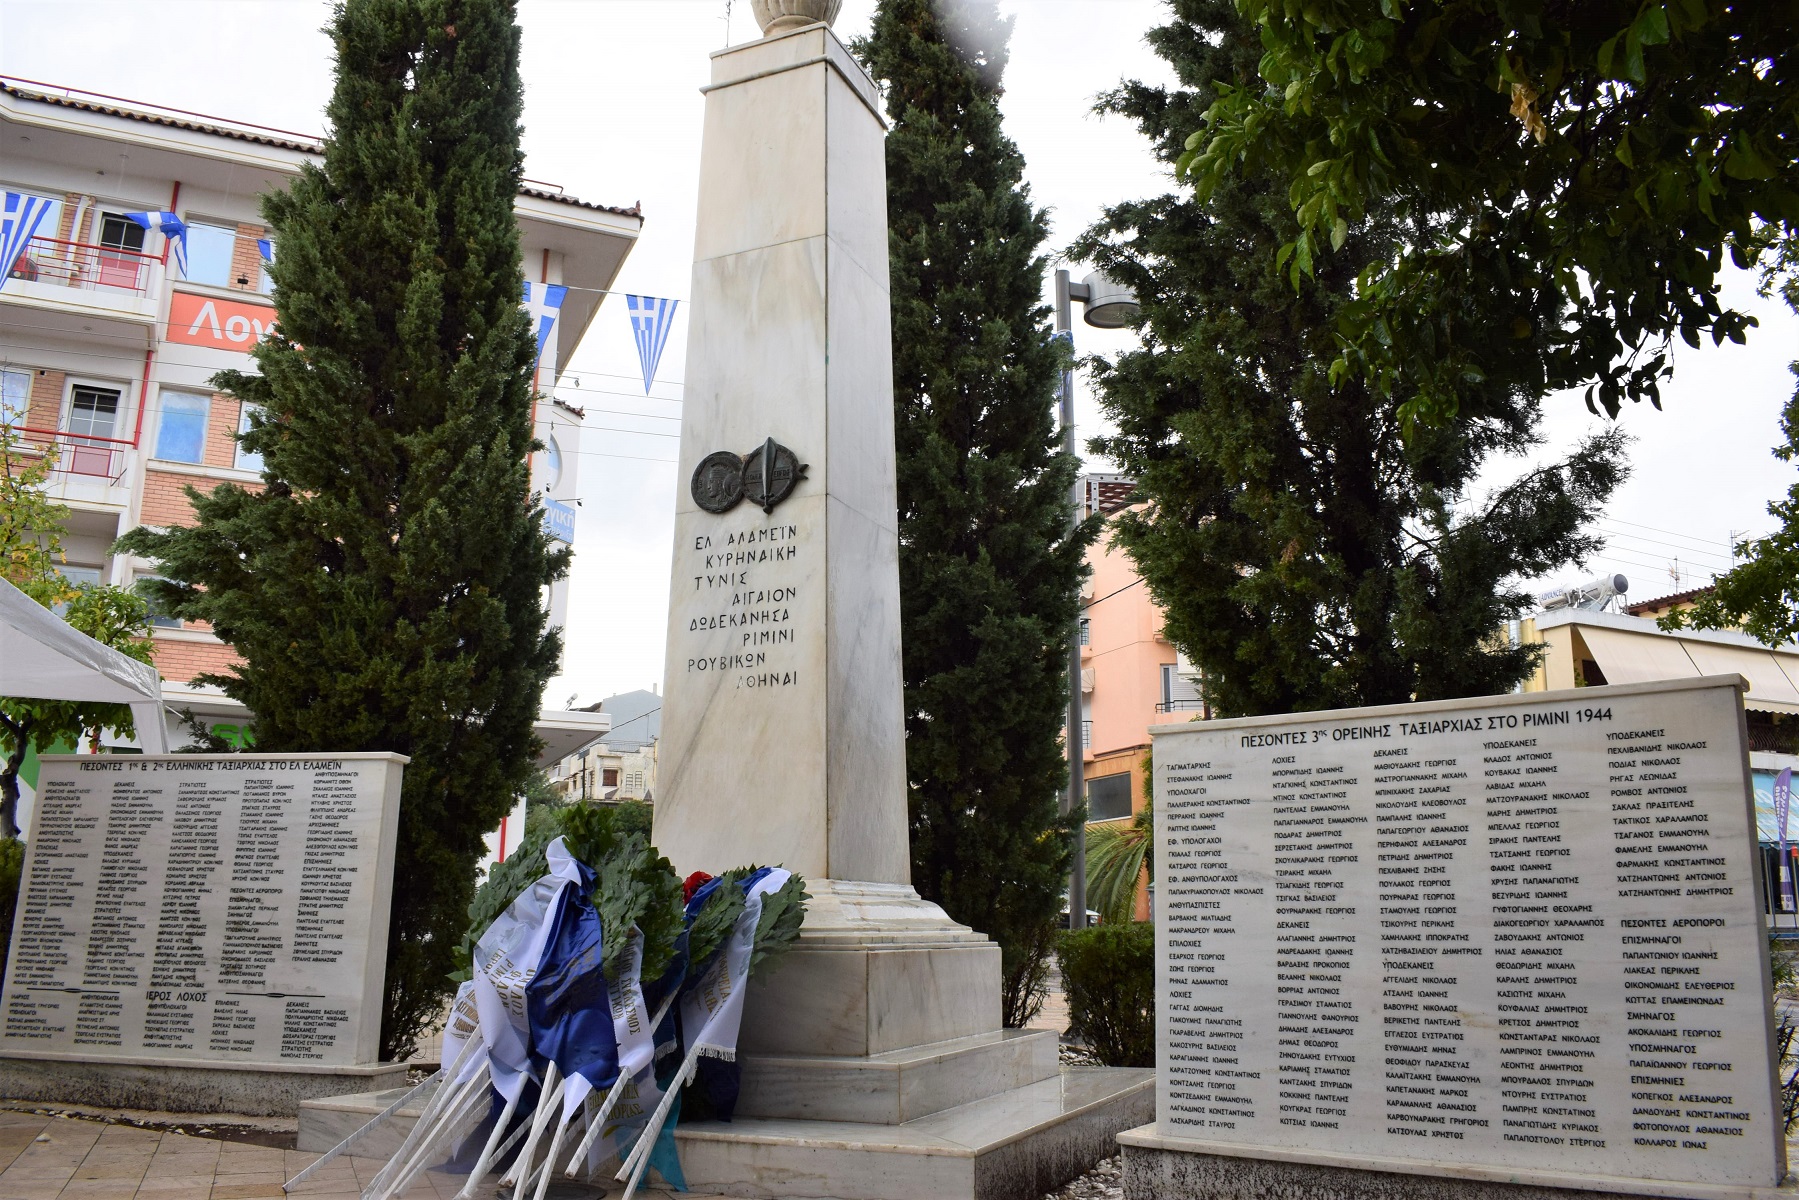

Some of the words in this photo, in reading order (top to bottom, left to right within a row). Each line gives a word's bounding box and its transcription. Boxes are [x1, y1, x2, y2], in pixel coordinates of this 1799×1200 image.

[695, 535, 712, 550] ΕΛ
[705, 545, 796, 569] ΚΥΡΗΝΑΙΚΗ
[694, 571, 748, 590] ΤΥΝΙΣ
[732, 586, 796, 606] ΑΙΓΑΙΟΝ
[689, 608, 790, 631] ΔΩΔΕΚΑΝΗΣΑ
[743, 628, 794, 647] ΡΙΜΙΝΙ
[687, 652, 766, 673] ΡΟΥΒΙΚΩΝ
[736, 670, 797, 690] ΑΘΗΝΑΙ
[1240, 730, 1308, 748] ΠΕΣΟΝΤΕΣ
[1331, 723, 1392, 742] ΟΡΕΙΝΗΣ
[1398, 716, 1483, 736] ΤΑΞΙΑΡΧΙΑΣ
[1486, 714, 1518, 730] ΣΤΟ
[1522, 710, 1570, 727] ΡΙΜΙΝΙ
[1575, 707, 1613, 723] 1944
[1605, 728, 1666, 741] ΥΠΟΔΕΚΑΝΕΙΣ
[1482, 738, 1538, 750] ΥΠΟΔΕΚΑΝΕΙΣ
[1606, 743, 1662, 755] ΠΕΧΛΙΒΑΝΙΔΗΣ
[1666, 740, 1707, 751] ΝΙΚΟΛΑΟΣ
[1372, 747, 1408, 758] ΔΕΚΑΝΕΙΣ
[1483, 754, 1512, 764] ΚΛΑΔΟΣ
[1515, 751, 1553, 762] ΑΝΤΩΝΙΟΣ
[1271, 755, 1296, 764] ΛΟΧΙΕΣ
[1373, 760, 1421, 770] ΜΑΘΙΟΥΔΑΚΗΣ
[1424, 758, 1457, 768] ΓΕΩΡΓΙΟΣ
[1608, 759, 1637, 769] ΠΟΔΙΑΣ
[1640, 756, 1681, 767] ΝΙΚΟΛΑΟΣ
[79, 762, 124, 771] ΠΕΣΟΝΤΕΣ
[166, 761, 215, 771] ΕΛΛΗΝΙΚΗΣ
[217, 761, 267, 771] ΤΑΞΙΑΡΧΙΑΣ
[268, 761, 287, 771] ΣΤΟ
[289, 761, 301, 771] ΕΛ
[1165, 761, 1211, 771] ΤΑΓΜΑΤΑΡΧΗΣ
[1483, 767, 1522, 777] ΚΟΥΒΑΚΑΣ
[1524, 765, 1558, 775] ΙΩΑΝΝΗΣ
[1373, 772, 1438, 783] ΜΑΣΤΡΟΓΙΑΝΝΑΚΗΣ
[1440, 771, 1468, 780] ΜΙΧΑΗΛ
[1609, 774, 1634, 783] ΡΗΓΑΣ
[1638, 771, 1677, 781] ΛΕΩΝΙΔΑΣ
[1418, 785, 1451, 794] ΖΑΧΑΡΙΑΣ
[1484, 781, 1515, 791] ΛΑΒΙΔΑΣ
[1518, 780, 1547, 788] ΜΙΧΑΗΛ
[1646, 785, 1688, 795] ΑΝΤΩΝΙΟΣ
[1485, 793, 1548, 804] ΜΑΤΖΟΥΡΑΝΑΚΗΣ
[1551, 790, 1590, 800] ΝΙΚΟΛΑΟΣ
[1375, 800, 1418, 809] ΝΙΚΟΛΟΥΔΗΣ
[1421, 797, 1467, 807] ΚΛΕΟΒΟΥΛΟΣ
[1611, 802, 1642, 812] ΣΑΚΛΑΣ
[1645, 799, 1695, 810] ΠΡΑΞΙΤΕΛΗΣ
[1273, 805, 1307, 814] ΠΑΝΤΕΛΙΑΣ
[1310, 804, 1350, 813] ΕΜΜΑΝΟΥΗΛ
[1486, 808, 1511, 817] ΜΑΡΗΣ
[1514, 806, 1558, 817] ΔΗΜΗΤΡΙΟΣ
[1612, 816, 1651, 825] ΤΑΚΤΙΚΟΣ
[1654, 813, 1709, 824] ΧΑΡΑΛΑΜΠΟΣ
[1487, 822, 1521, 831] ΜΠΕΛΛΑΣ
[1524, 820, 1560, 830] ΓΕΩΡΓΙΟΣ
[1488, 836, 1519, 845] ΣΙΡΑΚΗΣ
[1522, 834, 1562, 843] ΠΑΝΤΕΛΗΣ
[1613, 830, 1654, 840] ΤΣΑΓΑΝΟΣ
[1658, 828, 1710, 838] ΕΜΜΑΝΟΥΗΛ
[1488, 849, 1531, 859] ΤΣΑΤΣΑΝΗΣ
[1535, 848, 1571, 857] ΓΕΩΡΓΙΟΣ
[1614, 844, 1653, 854] ΦΑΜΕΛΗΣ
[1657, 843, 1709, 853] ΕΜΜΑΝΟΥΗΛ
[1615, 859, 1659, 868] ΦΑΡΜΑΚΗΣ
[1663, 857, 1726, 867] ΚΩΝΣΤΑΝΤΙΝΟΣ
[1167, 875, 1180, 883] ΕΦ.
[1181, 874, 1238, 883] ΑΝΘΥΠΟΛΟΓΑΧΟΣ
[1616, 873, 1680, 883] ΧΑΤΖΗΑΝΤΩΝΗΣ
[1684, 872, 1727, 881] ΑΝΤΩΝΙΟΣ
[1617, 888, 1681, 897] ΧΑΤΖΗΑΝΤΩΝΗΣ
[1685, 887, 1734, 896] ΔΗΜΗΤΡΙΟΣ
[1167, 900, 1221, 909] ΑΝΘΥΠΑΣΠΙΣΤΕΣ
[1492, 905, 1549, 914] ΓΥΦΤΟΓΙΑΝΝΗΣ
[1552, 904, 1593, 913] ΘΕΟΧΑΡΗΣ
[1276, 920, 1310, 929] ΔΕΚΑΝΕΙΣ
[1492, 919, 1550, 928] ΔΙΑΚΟΓΕΩΡΓΙΟΥ
[1553, 918, 1605, 927] ΧΑΡΑΛΑΜΠΟΣ
[1620, 918, 1667, 928] ΠΕΣΟΝΤΕΣ
[1672, 918, 1725, 928] ΑΕΡΟΠΟΡΟΙ
[1168, 939, 1202, 948] ΕΠΙΛΟΧΙΕΣ
[1621, 935, 1682, 945] ΕΠΙΣΜΗΝΑΓΟΙ
[1622, 951, 1680, 960] ΠΑΠΑΝΤΩΝΙΟΥ
[1682, 951, 1719, 960] ΙΩΑΝΝΗΣ
[1623, 966, 1656, 975] ΛΙΑΚΕΑΣ
[1660, 966, 1700, 975] ΠΕΡΙΚΛΗΣ
[1624, 980, 1680, 990] ΟΙΚΟΝΟΜΙΔΗΣ
[1684, 981, 1735, 990] ΕΛΕΥΘΕΡΙΟΣ
[145, 991, 172, 1001] ΙΕΡΟΣ
[176, 991, 208, 1003] ΛΟΧΟΣ
[1625, 995, 1657, 1005] ΚΩΤΤΑΣ
[1661, 996, 1724, 1006] ΕΠΑΜΕΙΝΩΝΔΑΣ
[1626, 1011, 1676, 1021] ΣΜΗΝΑΓΟΣ
[283, 1026, 317, 1034] ΥΠΟΔΕΚΑΝΕΙΣ
[1277, 1025, 1309, 1034] ΔΗΜΑΔΗΣ
[1311, 1026, 1354, 1036] ΑΛΕΞΑΝΔΡΟΣ
[1627, 1027, 1678, 1037] ΑΚΟΚΑΛΙΔΗΣ
[1682, 1029, 1722, 1038] ΓΕΩΡΓΙΟΣ
[1498, 1032, 1557, 1042] ΚΩΝΣΤΑΝΤΑΡΑΣ
[1561, 1034, 1600, 1044] ΝΙΚΟΛΑΟΣ
[1628, 1043, 1697, 1054] ΥΠΟΣΜΗΝΑΓΟΣ
[1692, 1061, 1732, 1071] ΓΕΩΡΓΙΟΣ
[1435, 1073, 1481, 1084] ΕΜΜΑΝΟΥΗΛ
[1630, 1075, 1685, 1086] ΕΠΙΣΜΗΝΙΕΣ
[1630, 1091, 1674, 1102] ΚΟΠΕΓΚΟΣ
[1678, 1094, 1733, 1105] ΑΛΕΞΑΝΔΡΟΣ
[1502, 1104, 1538, 1114] ΠΑΜΠΡΗΣ
[1632, 1107, 1681, 1118] ΔΑΝΔΟΥΔΗΣ
[1685, 1109, 1751, 1121] ΚΩΝΣΤΑΝΤΙΝΟΣ
[1169, 1116, 1205, 1127] ΛΑΣΚΑΡΙΔΗΣ
[1208, 1119, 1236, 1130] ΣΤΑΥΡΟΣ
[1279, 1117, 1307, 1127] ΚΩΤΣΙΑΣ
[1310, 1120, 1339, 1130] ΙΩΑΝΝΗΣ
[1386, 1112, 1446, 1124] ΚΑΡΒΟΥΝΑΡΑΚΗΣ
[1449, 1116, 1489, 1128] ΓΡΗΓΟΡΙΟΣ
[1387, 1126, 1428, 1137] ΚΑΤΣΟΥΛΑΣ
[1431, 1130, 1464, 1140] ΧΡΗΣΤΟΣ
[1632, 1121, 1691, 1133] ΦΩΤΟΠΟΥΛΟΣ
[1695, 1125, 1743, 1136] ΑΘΑΝΑΣΙΟΣ
[1503, 1133, 1565, 1145] ΠΑΠΑΠΟΣΤΟΛΟΥ
[1569, 1137, 1606, 1148] ΣΤΕΡΓΙΟΣ
[1633, 1137, 1677, 1148] ΚΟΛΛΑΡΟΣ
[1682, 1140, 1708, 1150] ΙΩΝΑΣ
